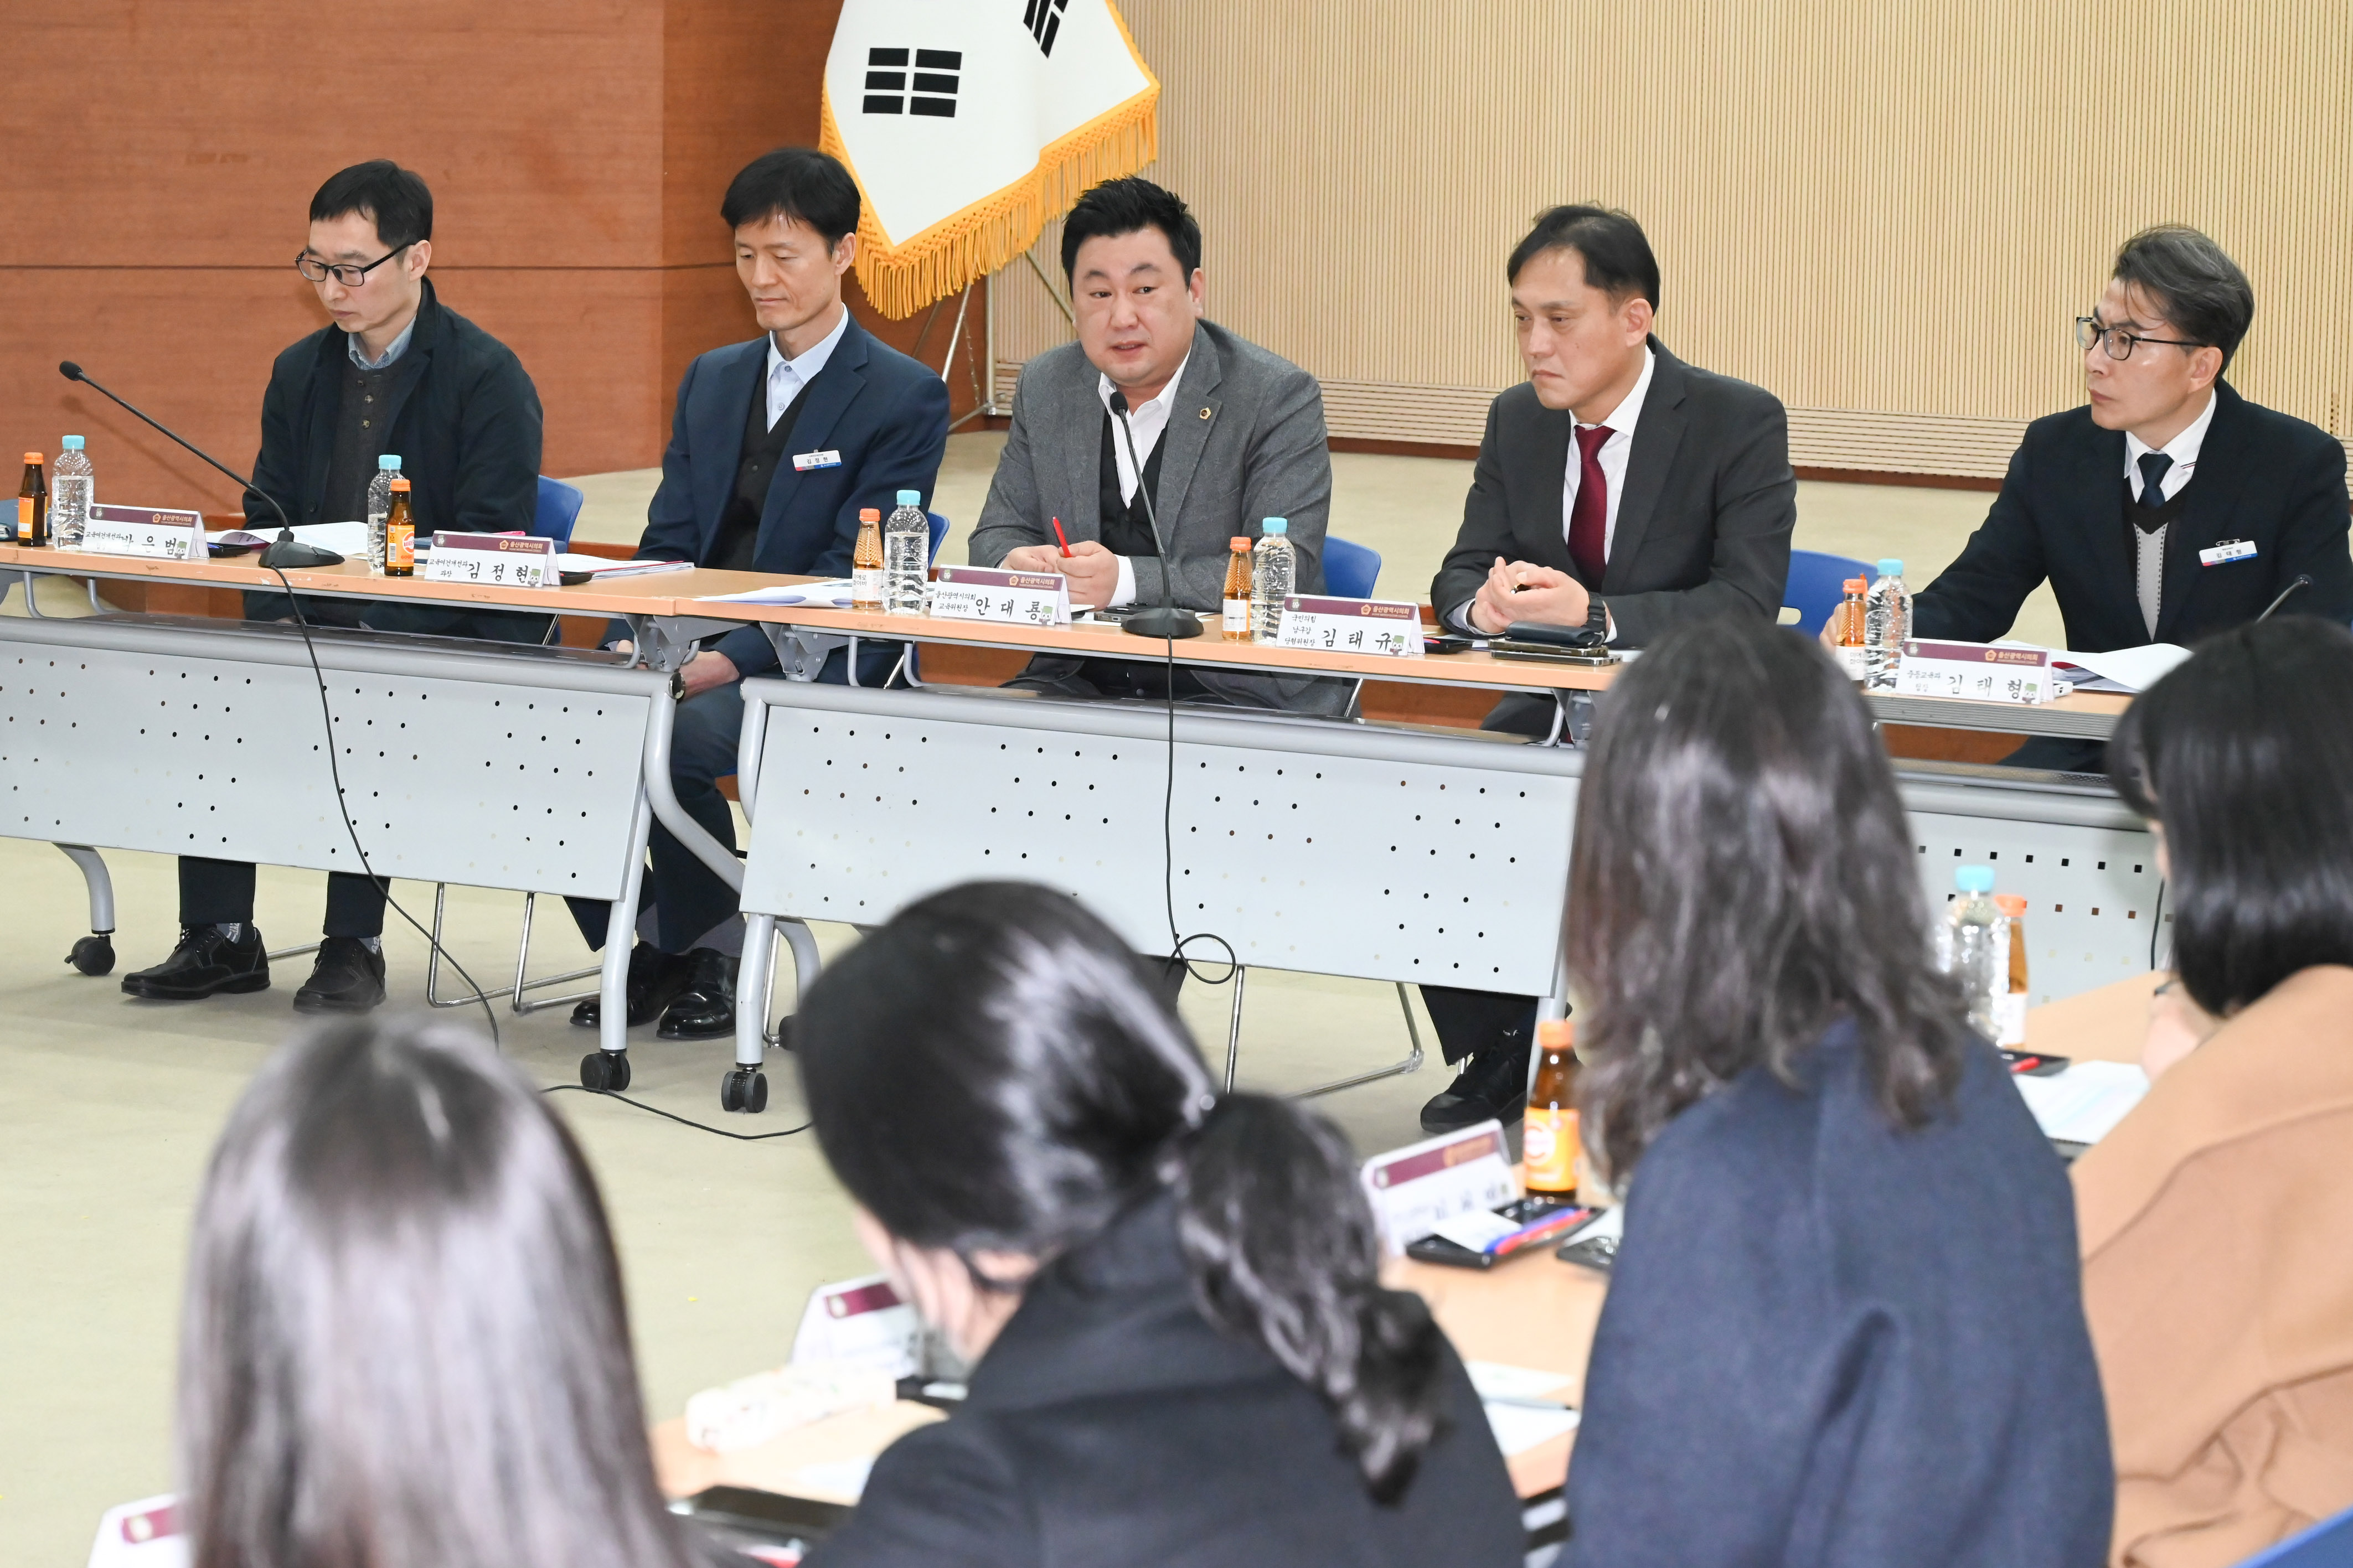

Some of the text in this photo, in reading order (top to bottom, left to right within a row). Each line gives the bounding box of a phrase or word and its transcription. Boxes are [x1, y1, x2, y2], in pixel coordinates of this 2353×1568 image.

[162, 514, 193, 523] 울산광역시의회
[510, 541, 543, 550] 울산광역시의회
[429, 558, 468, 568] 교육여건개선과
[467, 561, 529, 583] 김정현
[1020, 576, 1055, 586] 울산광역시의회
[935, 591, 976, 601] 울산광역시의회
[938, 603, 968, 612] 교육위원장
[976, 597, 1041, 620] 안대룡
[1372, 606, 1410, 615] 울산광역시의회
[1292, 615, 1317, 623] 국민의힘
[1293, 626, 1312, 635] 남구갑
[1284, 637, 1315, 647] 당협위원장
[1322, 628, 1392, 652] 김태규
[1998, 651, 2039, 661] 울산광역시의회
[1907, 670, 1941, 679] 중등교육과
[1947, 674, 2022, 700] 김태형
